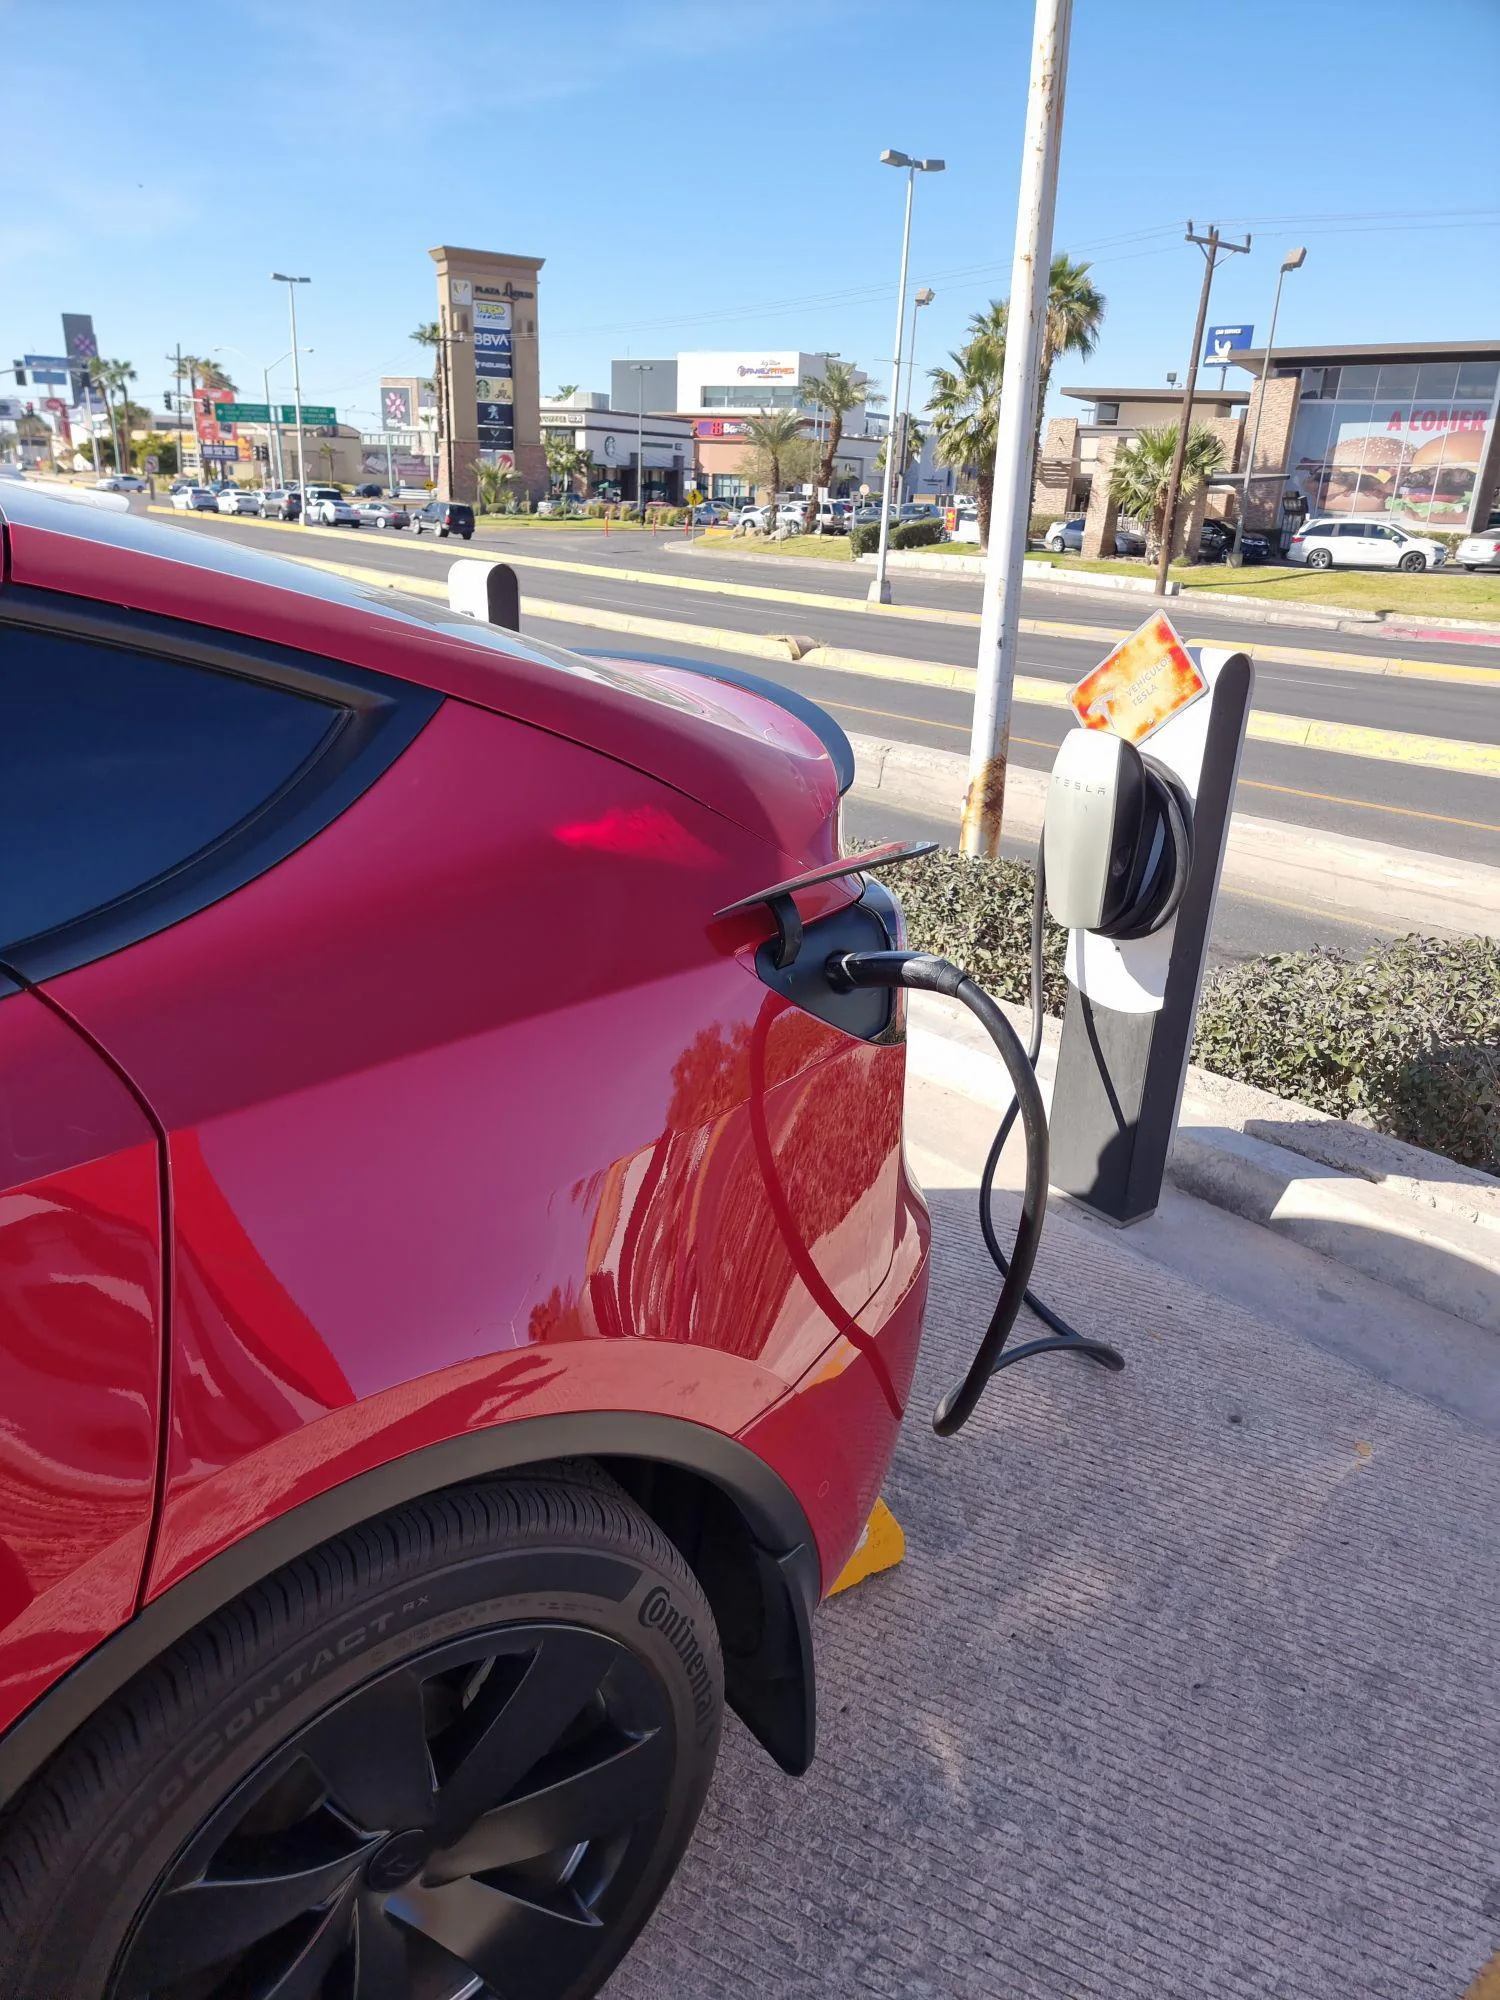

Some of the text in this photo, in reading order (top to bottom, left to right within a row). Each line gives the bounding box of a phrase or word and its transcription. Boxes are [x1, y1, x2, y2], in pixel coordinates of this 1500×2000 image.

[474, 333, 509, 346] BBVA
[1386, 409, 1487, 431] A COMER
[1126, 655, 1172, 697] VEHICULOS
[1132, 684, 1158, 706] TESLA
[1055, 776, 1106, 796] TESLA
[637, 1585, 716, 1726] Continental
